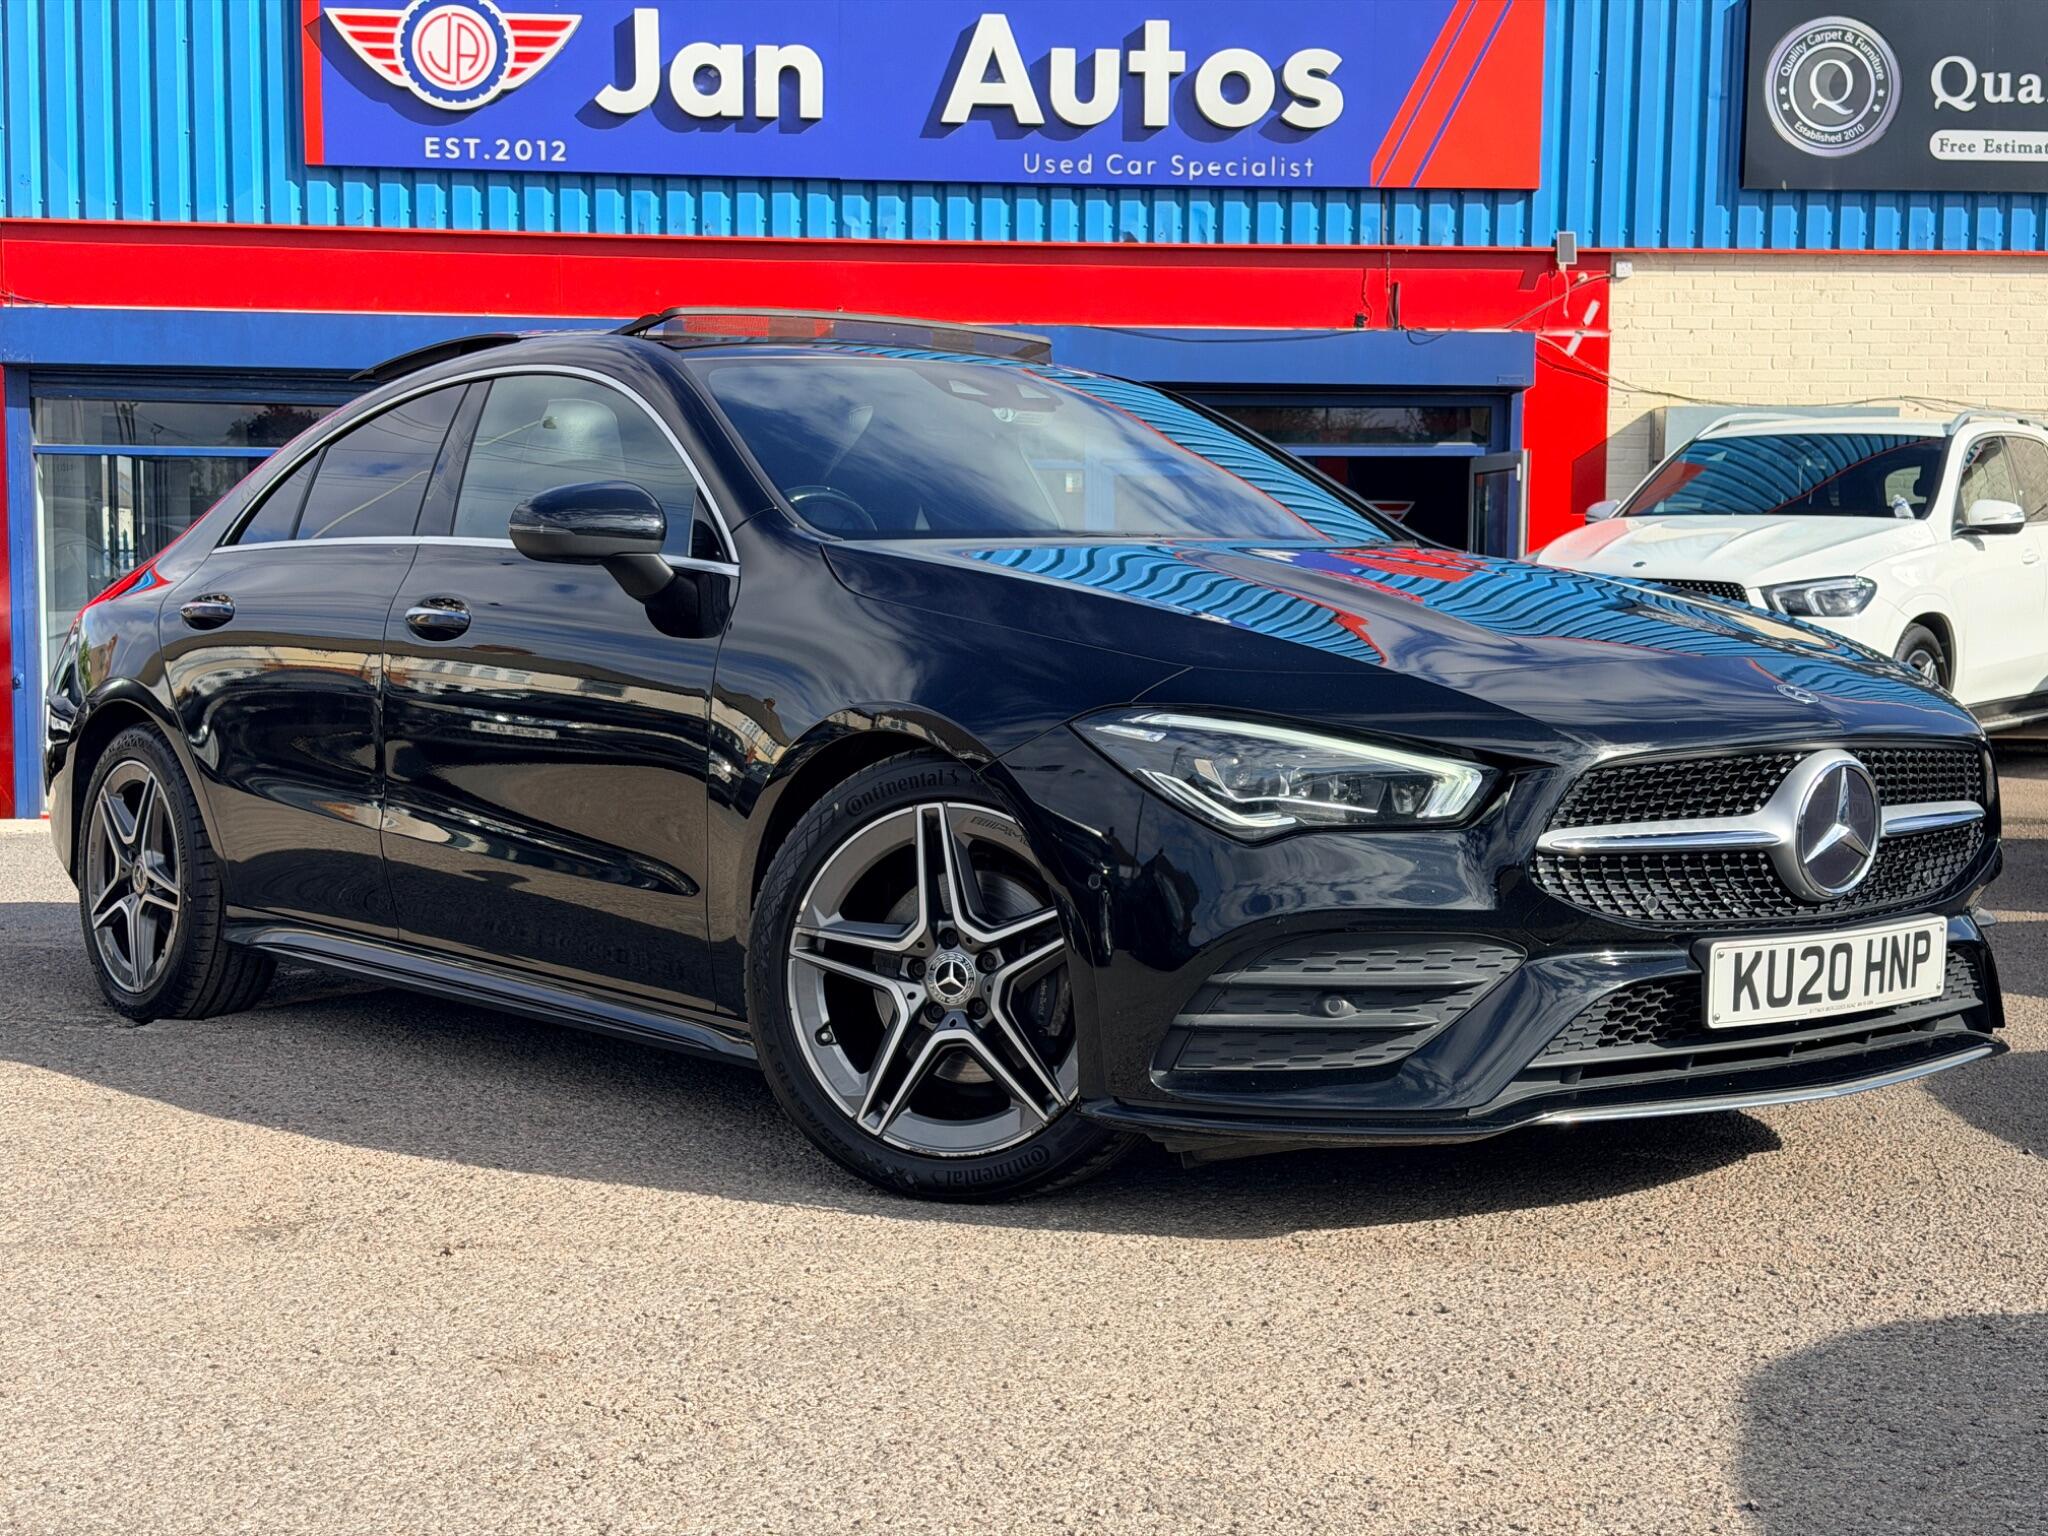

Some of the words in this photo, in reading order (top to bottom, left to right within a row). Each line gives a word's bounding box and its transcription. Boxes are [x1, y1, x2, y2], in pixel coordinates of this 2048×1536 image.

[594, 8, 823, 118] Jan
[940, 13, 1345, 128] Autos
[1780, 41, 1808, 76] Quality
[1807, 31, 1843, 44] Carpet
[1844, 31, 1855, 43] &
[1855, 38, 1884, 80] Furniture
[1810, 59, 1854, 115] Q
[1930, 55, 2048, 112] Qua
[424, 137, 567, 162] EST.2012
[1794, 121, 1842, 143] Established
[1844, 124, 1866, 140] 2010
[1938, 137, 1977, 153] Free
[1023, 153, 1093, 175] Used
[1106, 154, 1156, 176] Car
[1170, 156, 1315, 180] Specialist
[1732, 942, 1854, 1012] KU20
[1863, 930, 1932, 996] HNP
